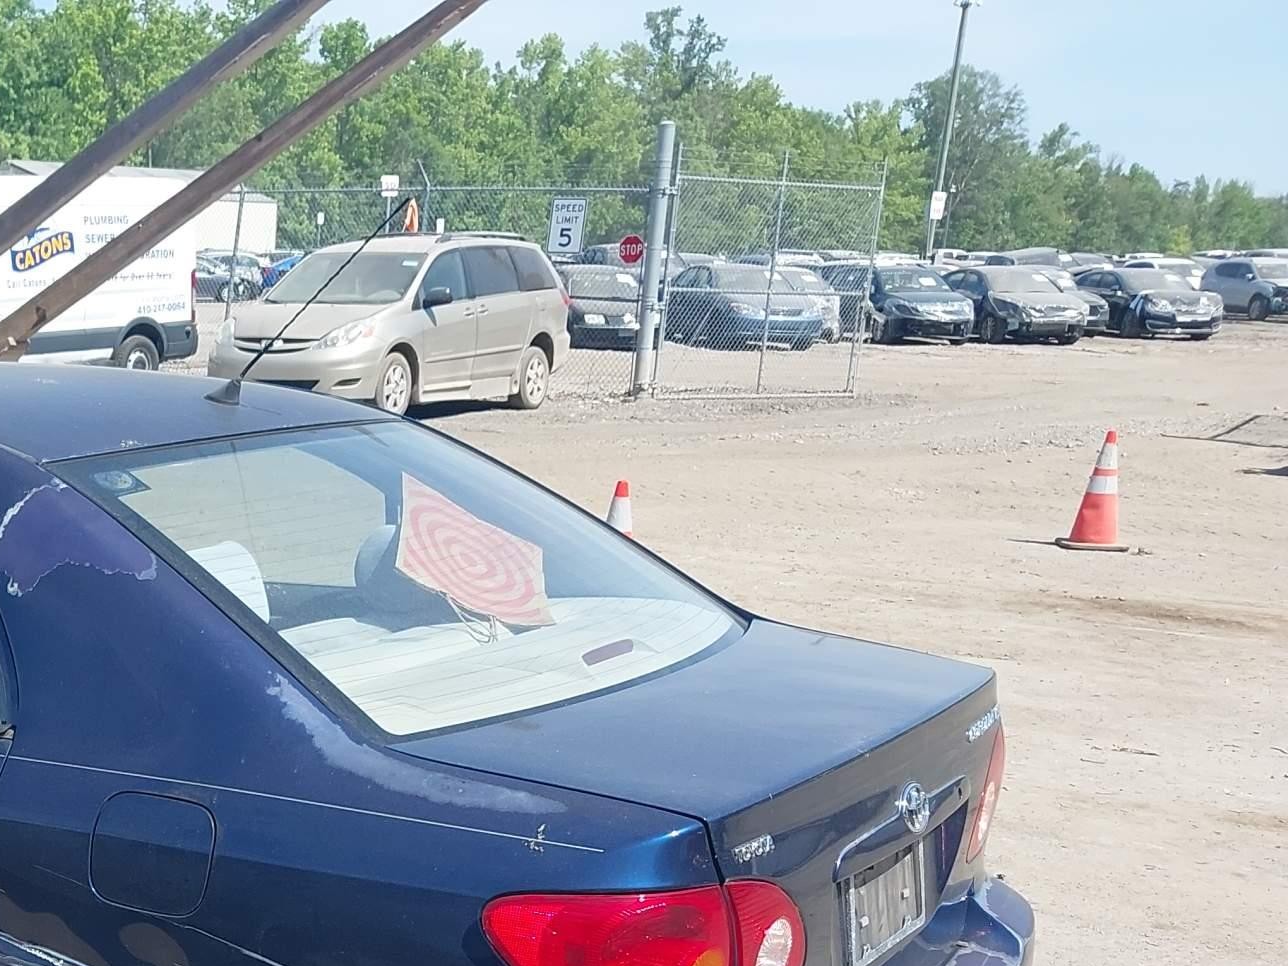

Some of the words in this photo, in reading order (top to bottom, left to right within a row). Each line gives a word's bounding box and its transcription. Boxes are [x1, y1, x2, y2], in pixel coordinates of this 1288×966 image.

[554, 203, 584, 213] SPEED
[83, 215, 129, 225] PLUMBING
[555, 216, 580, 225] LIMIT
[85, 232, 116, 244] SEWER
[557, 227, 572, 248] 5
[15, 232, 72, 271] CATONS
[620, 244, 643, 257] STOP
